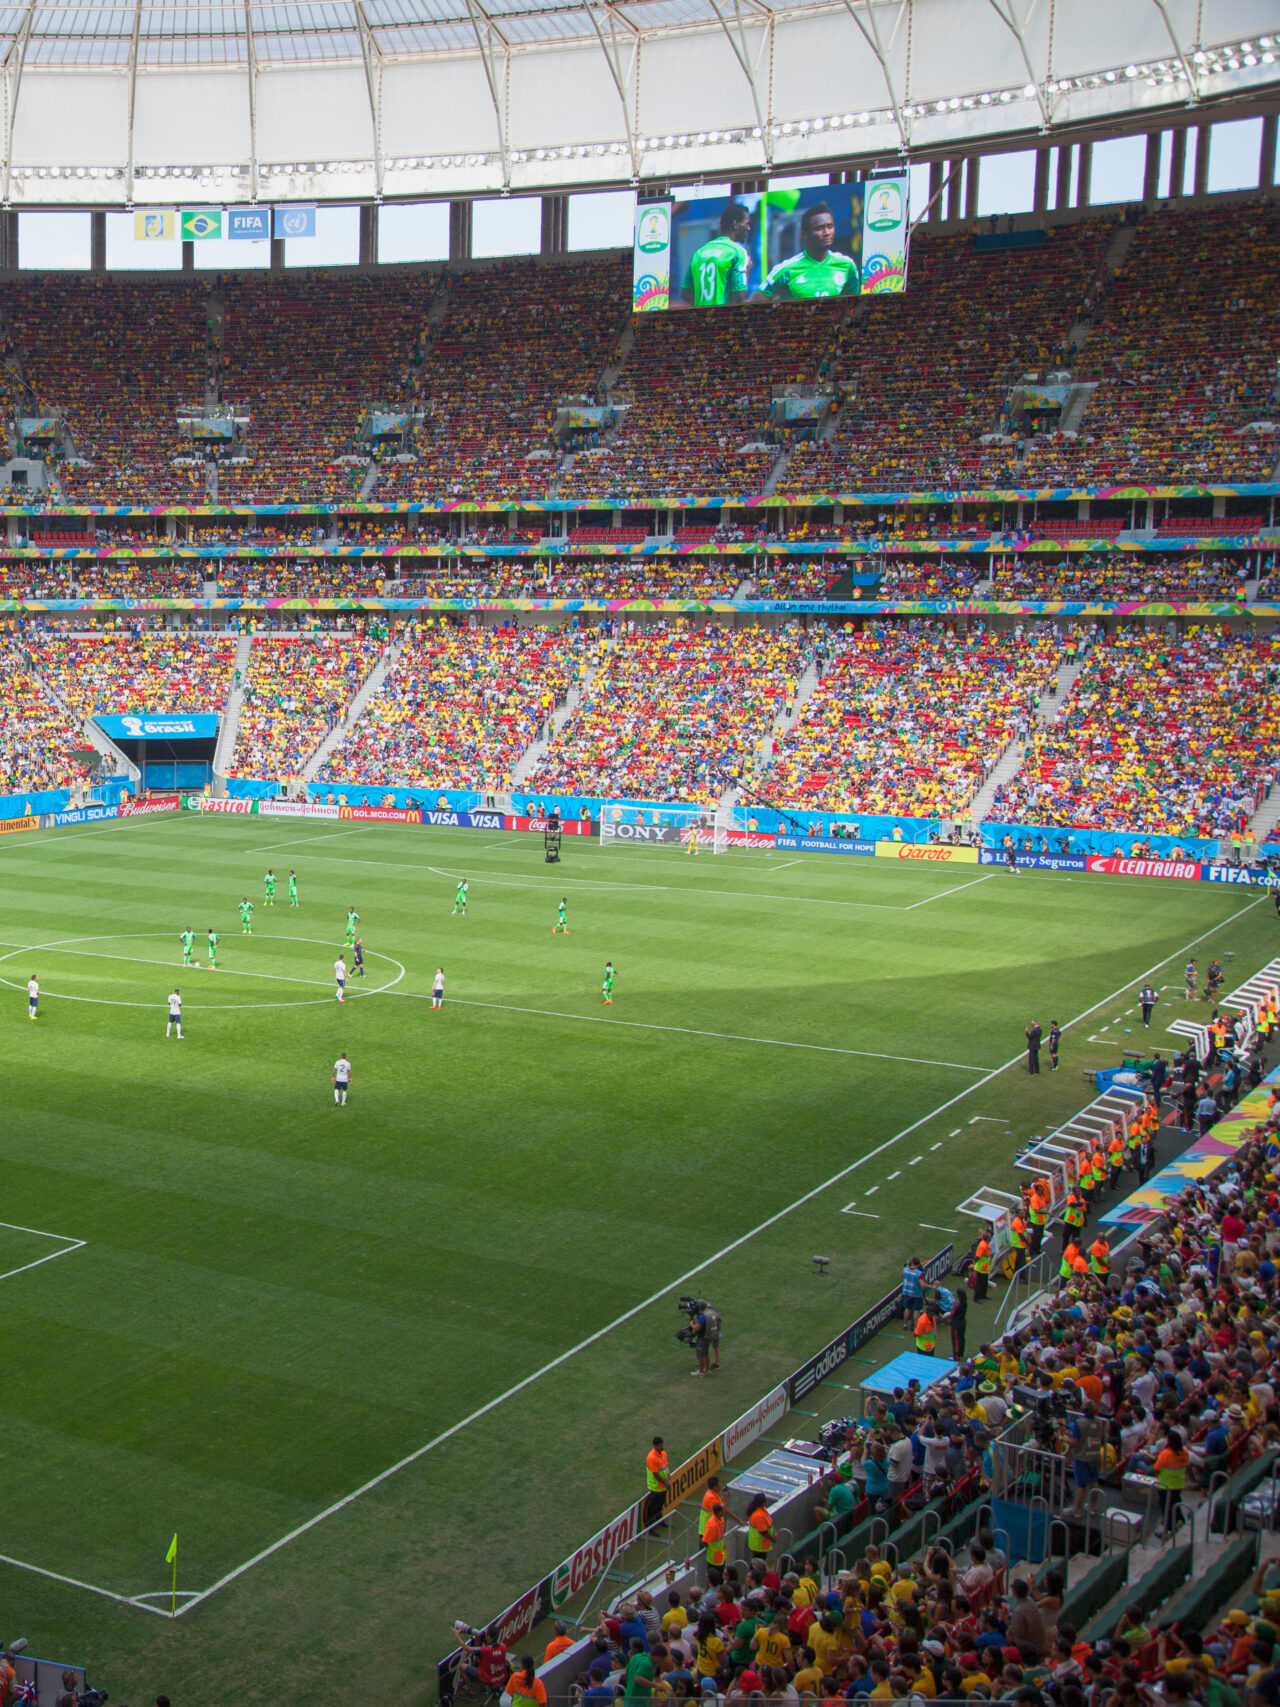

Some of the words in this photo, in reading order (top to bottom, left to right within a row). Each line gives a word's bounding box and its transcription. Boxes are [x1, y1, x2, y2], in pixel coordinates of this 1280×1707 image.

[234, 216, 263, 228] FIFA
[699, 262, 716, 301] 13
[144, 723, 196, 734] Brasil
[121, 800, 178, 817] Budweiser
[201, 798, 251, 814] Castrol
[353, 809, 406, 820] GOL.MCD.COM
[55, 810, 85, 825] YINGLI
[87, 806, 118, 820] SOLAR
[427, 811, 459, 826] VISA
[468, 814, 500, 829] VISA
[602, 823, 669, 840] SONY
[778, 838, 797, 847] FIFA
[801, 840, 837, 850] FOOTBALL
[839, 843, 853, 851] FOR
[855, 844, 874, 852] HOPE
[898, 843, 952, 861] Garoto
[996, 853, 1037, 868] Lierty
[1039, 856, 1084, 870] Seguros
[1118, 859, 1195, 879] CENTAURO
[815, 1342, 846, 1381] adidas
[571, 1505, 636, 1593] Castrol
